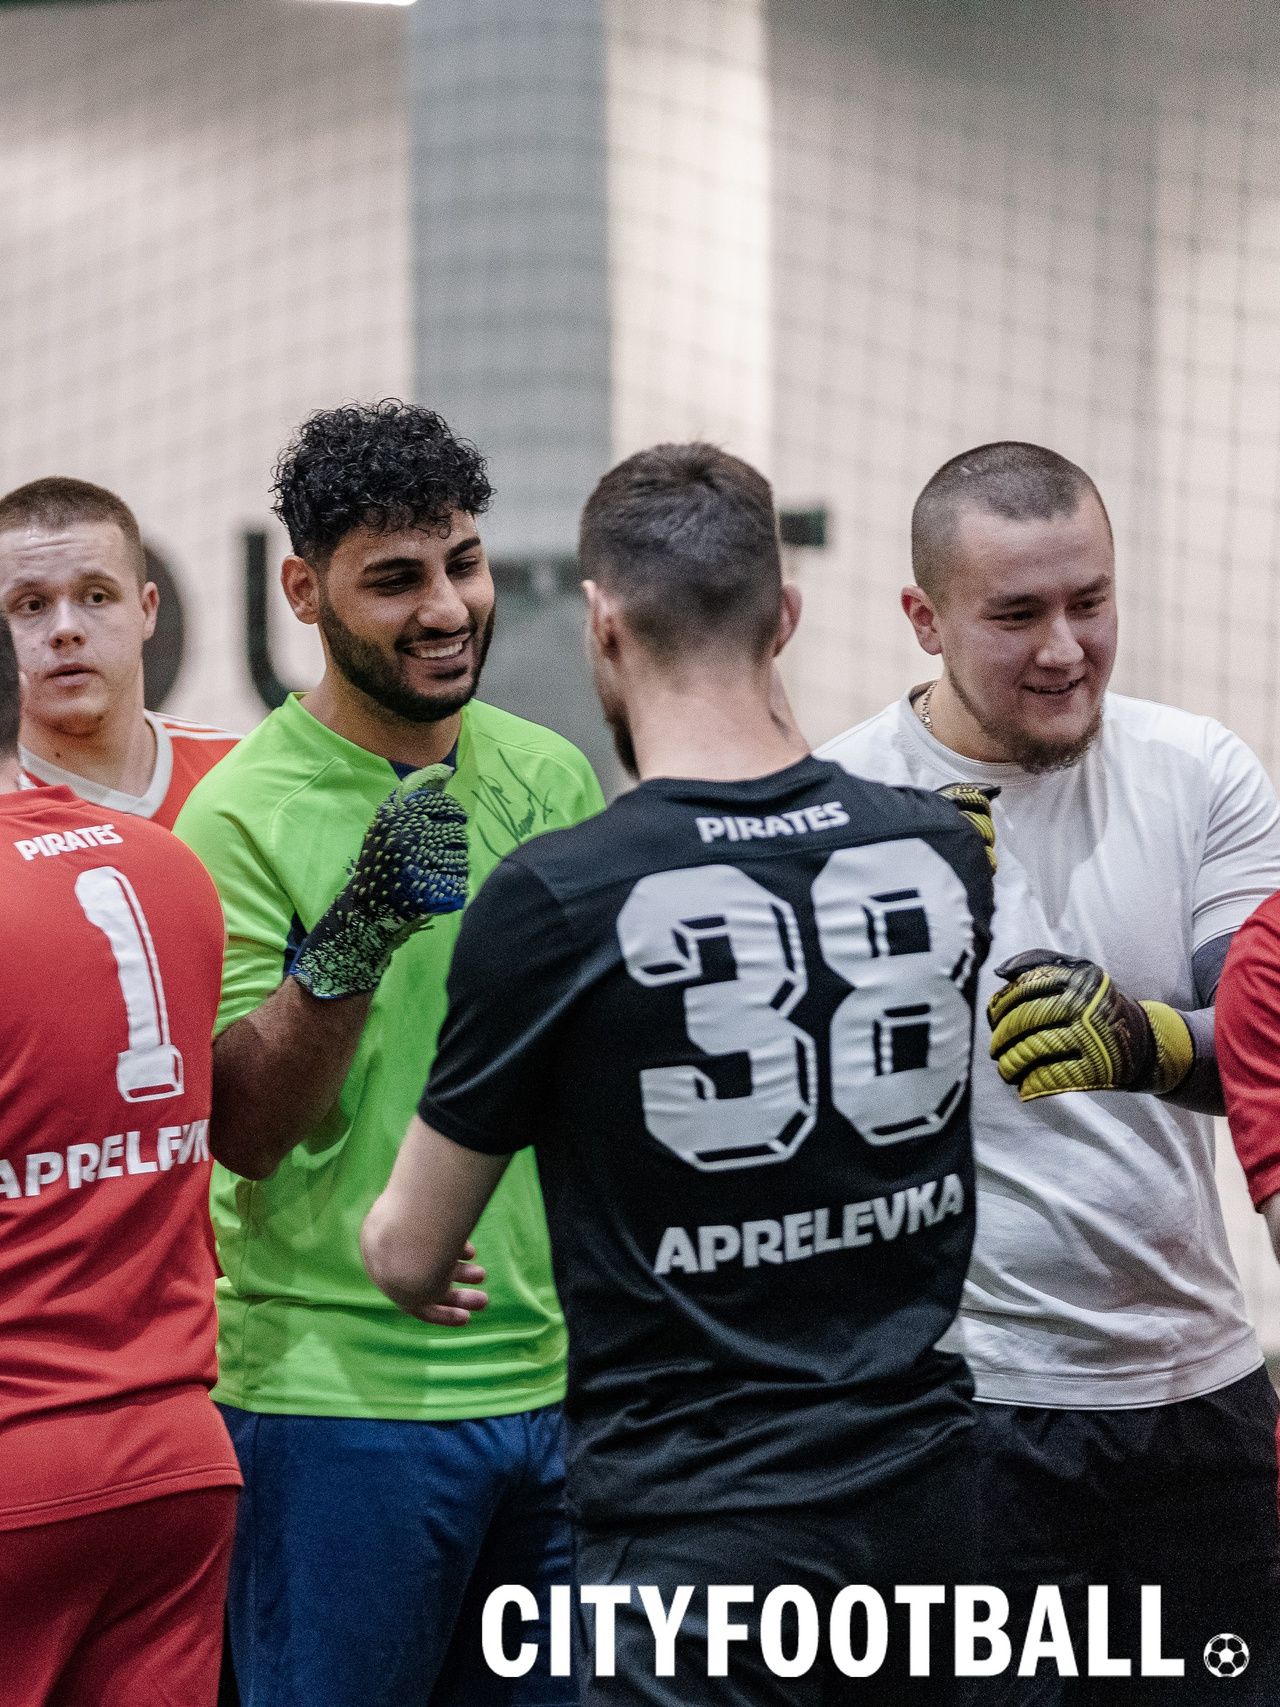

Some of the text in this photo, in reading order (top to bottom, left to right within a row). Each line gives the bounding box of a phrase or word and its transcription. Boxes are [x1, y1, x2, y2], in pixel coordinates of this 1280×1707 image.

[14, 824, 124, 860] PIRATES
[695, 801, 850, 843] PIRATES
[74, 865, 185, 1103] 1
[617, 837, 976, 1172] 38
[653, 1173, 965, 1276] APRELEVKA
